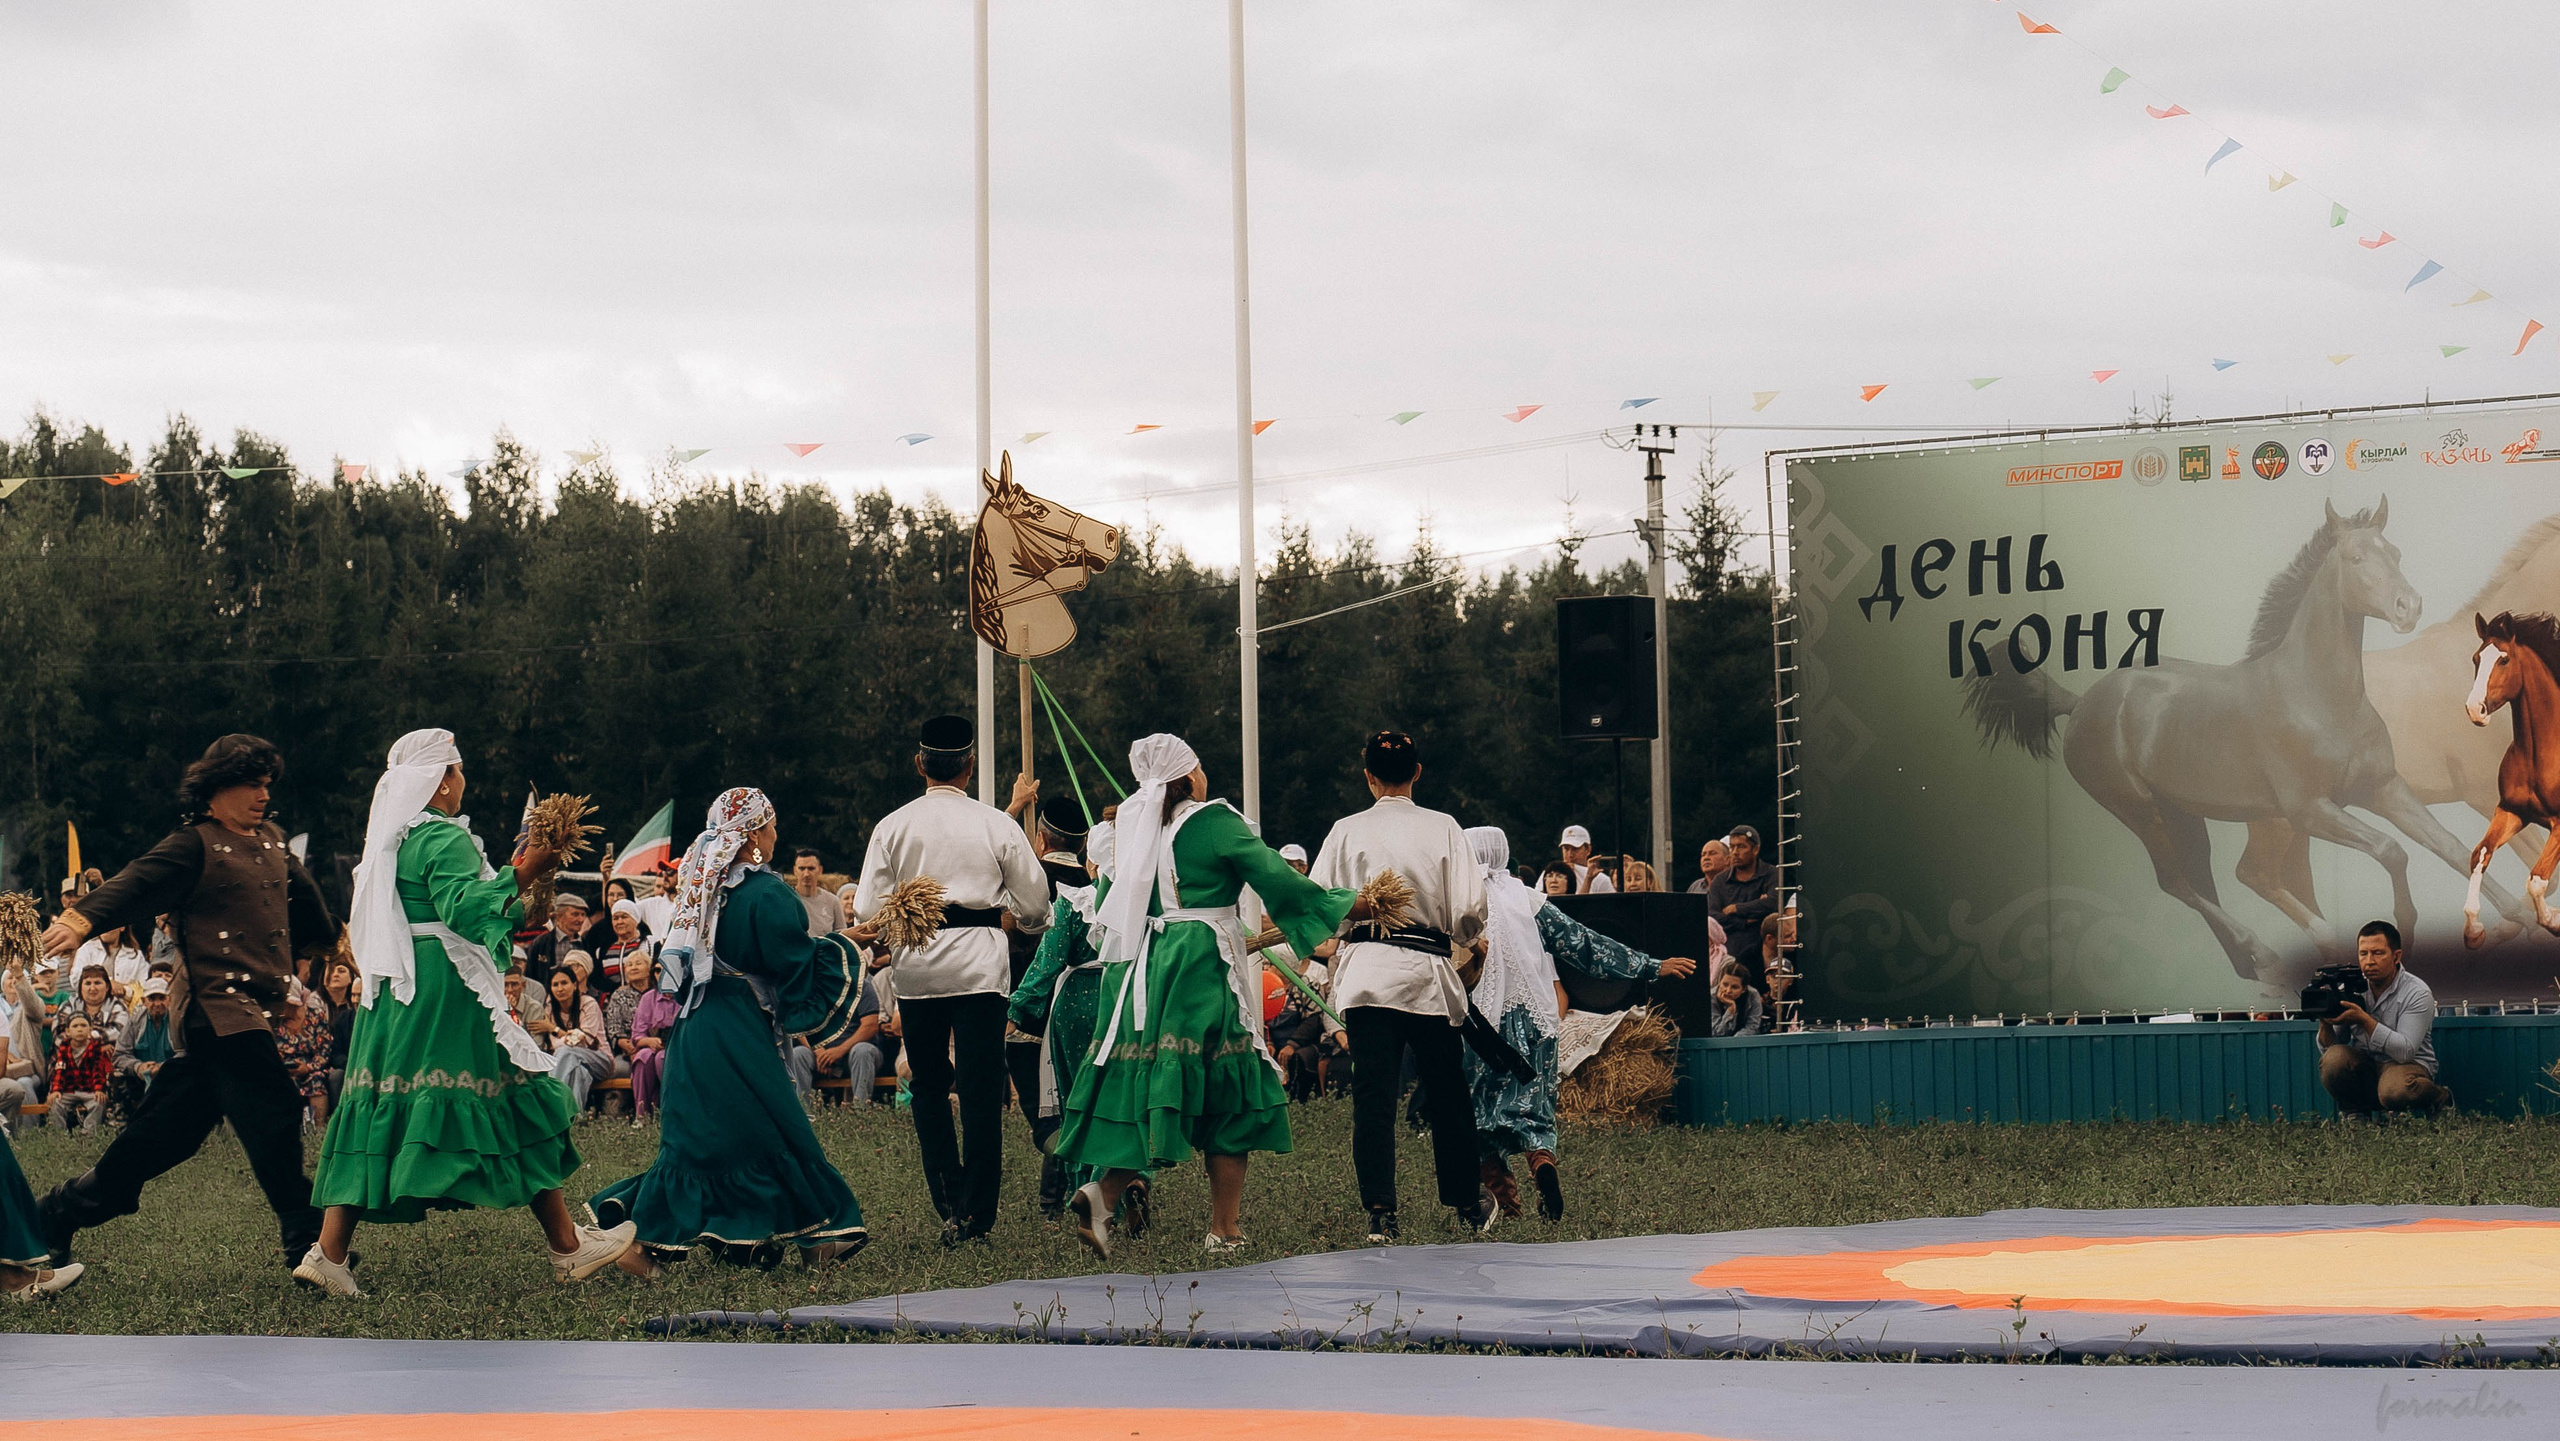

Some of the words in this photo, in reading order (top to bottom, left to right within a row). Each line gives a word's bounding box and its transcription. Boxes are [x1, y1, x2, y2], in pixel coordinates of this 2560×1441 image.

[2360, 446, 2408, 458] КЫРЛАЙ
[2420, 447, 2492, 467] КАЗАНЬ
[2010, 463, 2121, 483] МИНСПОРТ
